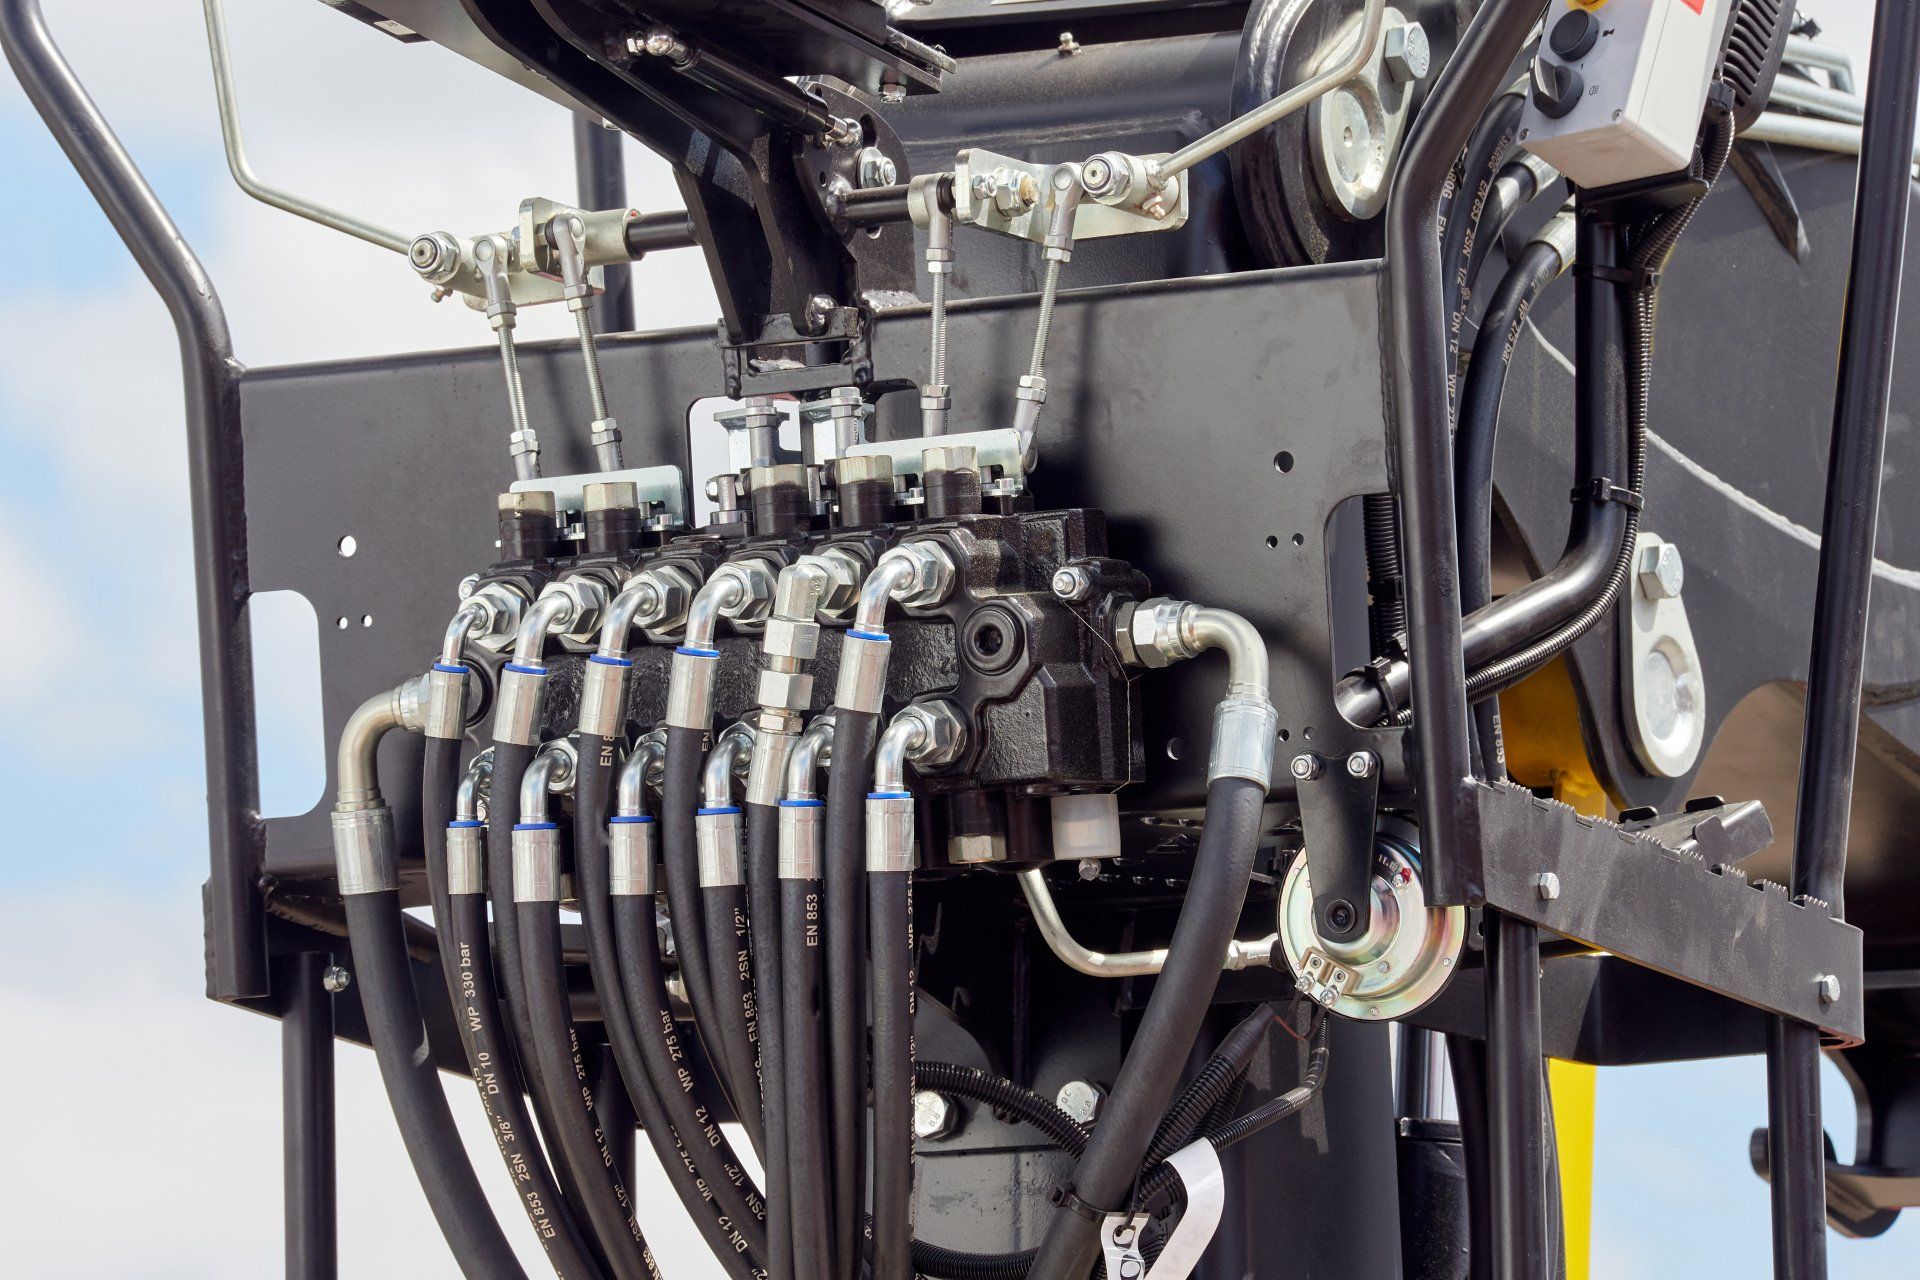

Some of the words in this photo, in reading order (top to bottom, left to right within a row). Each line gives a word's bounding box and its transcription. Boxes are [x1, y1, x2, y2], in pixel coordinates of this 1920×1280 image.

[1478, 179, 1488, 199] EN
[1471, 200, 1481, 221] 853
[1462, 228, 1474, 257] 2SN
[1519, 299, 1529, 321] WP
[1452, 311, 1461, 334] DN
[1509, 320, 1520, 342] 275
[1450, 338, 1458, 354] 12
[1502, 344, 1513, 366] bar
[1448, 374, 1456, 398] WP
[1492, 714, 1501, 735] EN
[702, 732, 710, 752] EN
[600, 746, 613, 767] EN
[807, 893, 818, 920] 853
[807, 924, 818, 947] EN
[460, 942, 471, 968] bar
[738, 950, 751, 981] 2SN
[463, 972, 476, 998] 330
[745, 992, 756, 1019] 853
[468, 1006, 482, 1033] WP
[661, 1009, 674, 1034] bar
[569, 1027, 579, 1053] bar
[749, 1022, 758, 1043] EN
[666, 1035, 683, 1062] 275
[478, 1052, 491, 1071] 10
[573, 1054, 585, 1080] 275
[483, 1073, 499, 1095] DN
[677, 1068, 694, 1093] WP
[582, 1086, 594, 1112] WP
[695, 1105, 710, 1124] 12
[928, 1112, 941, 1128] 8.8
[594, 1128, 604, 1143] 12
[703, 1126, 721, 1148] DN
[511, 1153, 531, 1182] 2SN
[601, 1147, 612, 1168] DN
[696, 1178, 714, 1202] WP
[526, 1191, 545, 1216] 853
[745, 1192, 767, 1220] 2SN
[538, 1218, 556, 1239] EN
[718, 1215, 733, 1231] 12
[729, 1230, 748, 1254] DN
